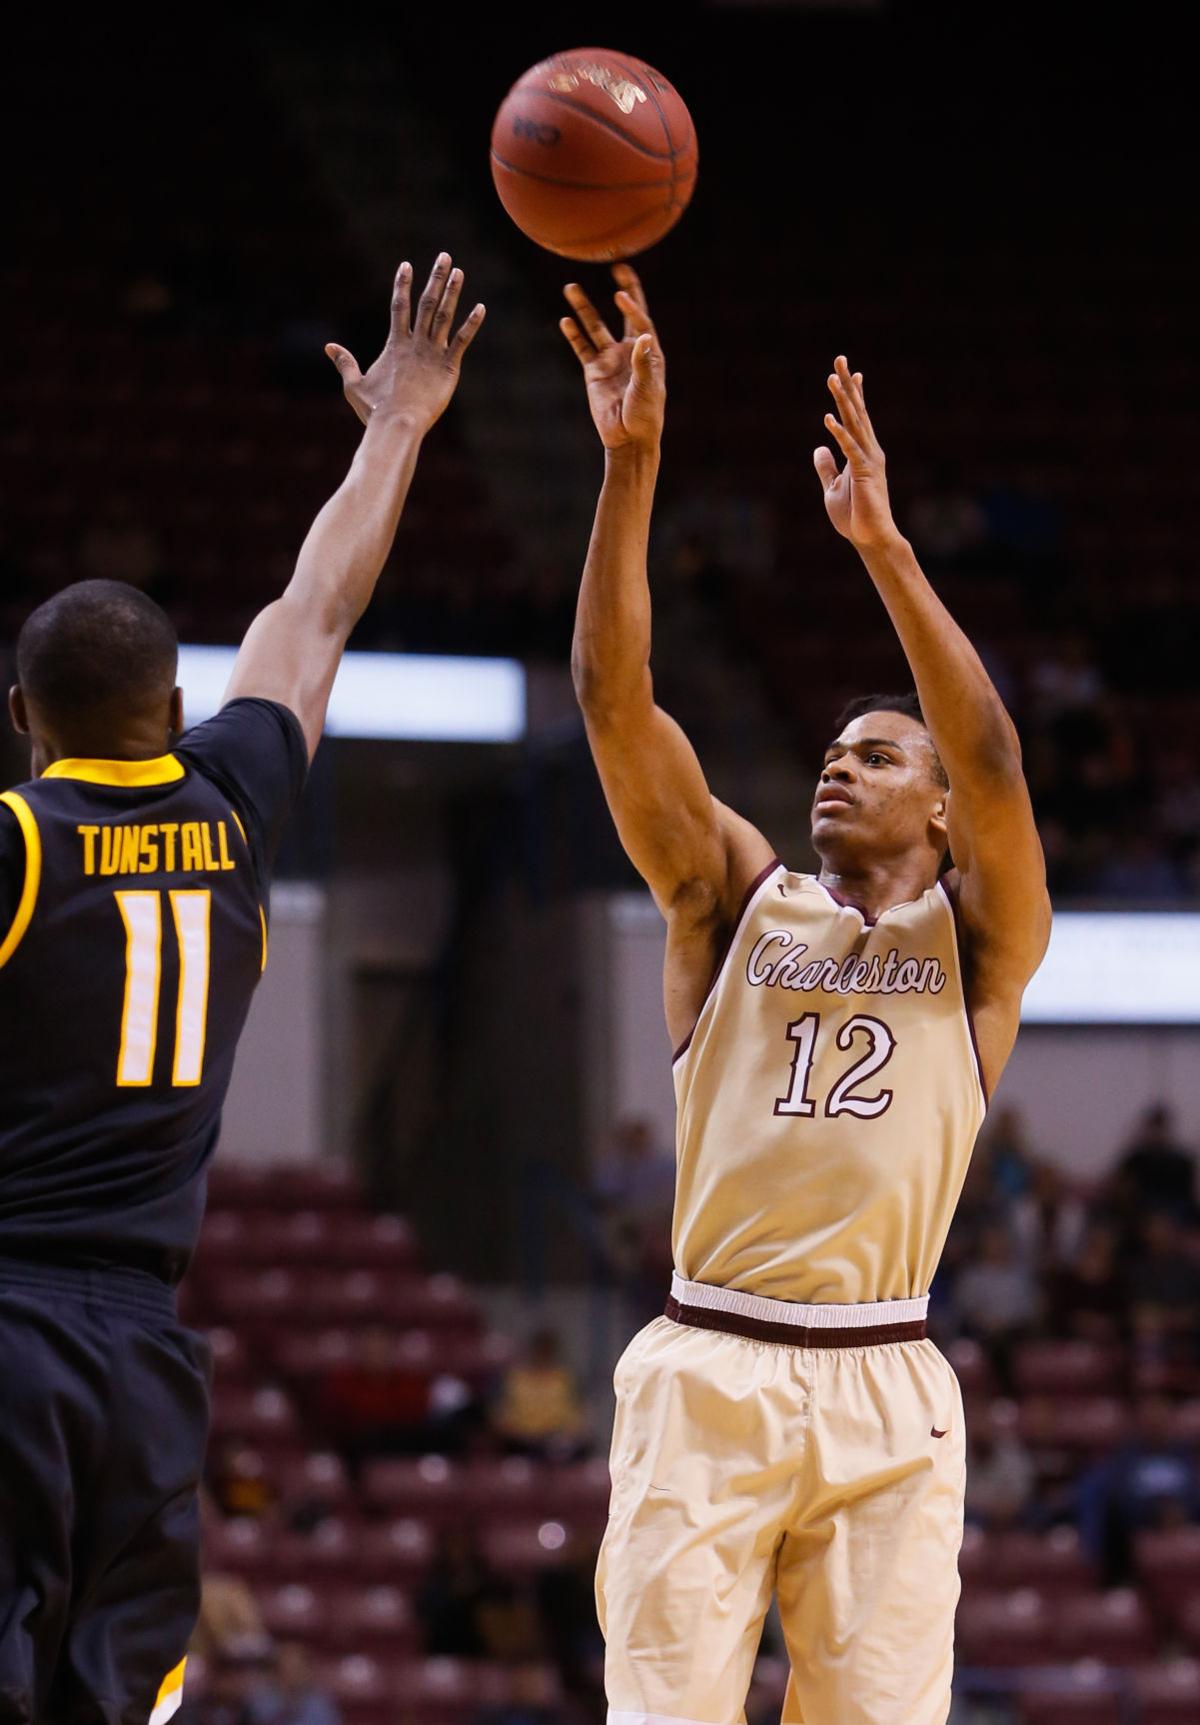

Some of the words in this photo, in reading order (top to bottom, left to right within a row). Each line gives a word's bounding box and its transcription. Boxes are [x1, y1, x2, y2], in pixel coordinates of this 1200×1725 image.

[78, 821, 236, 875] TUNSTALL
[113, 889, 212, 1087] 11
[746, 930, 946, 994] Charleston
[773, 1012, 897, 1119] 12
